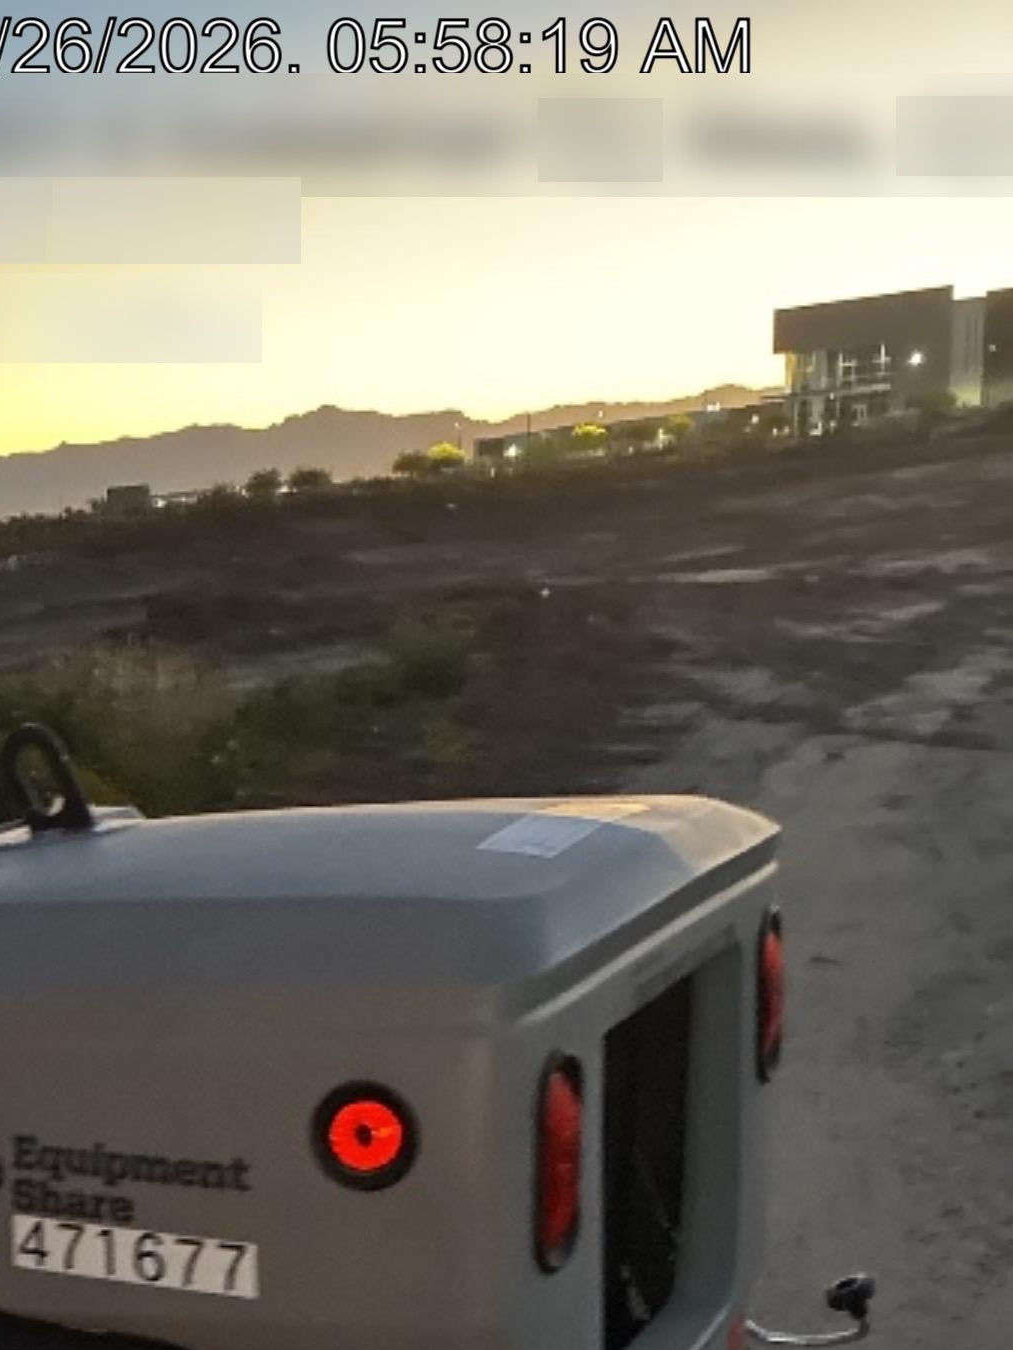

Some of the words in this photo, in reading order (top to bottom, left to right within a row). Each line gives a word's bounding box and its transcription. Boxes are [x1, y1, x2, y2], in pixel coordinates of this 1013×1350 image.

[10, 1134, 251, 1192] Equipment
[10, 1178, 135, 1224] Share
[19, 1220, 248, 1290] 471677
